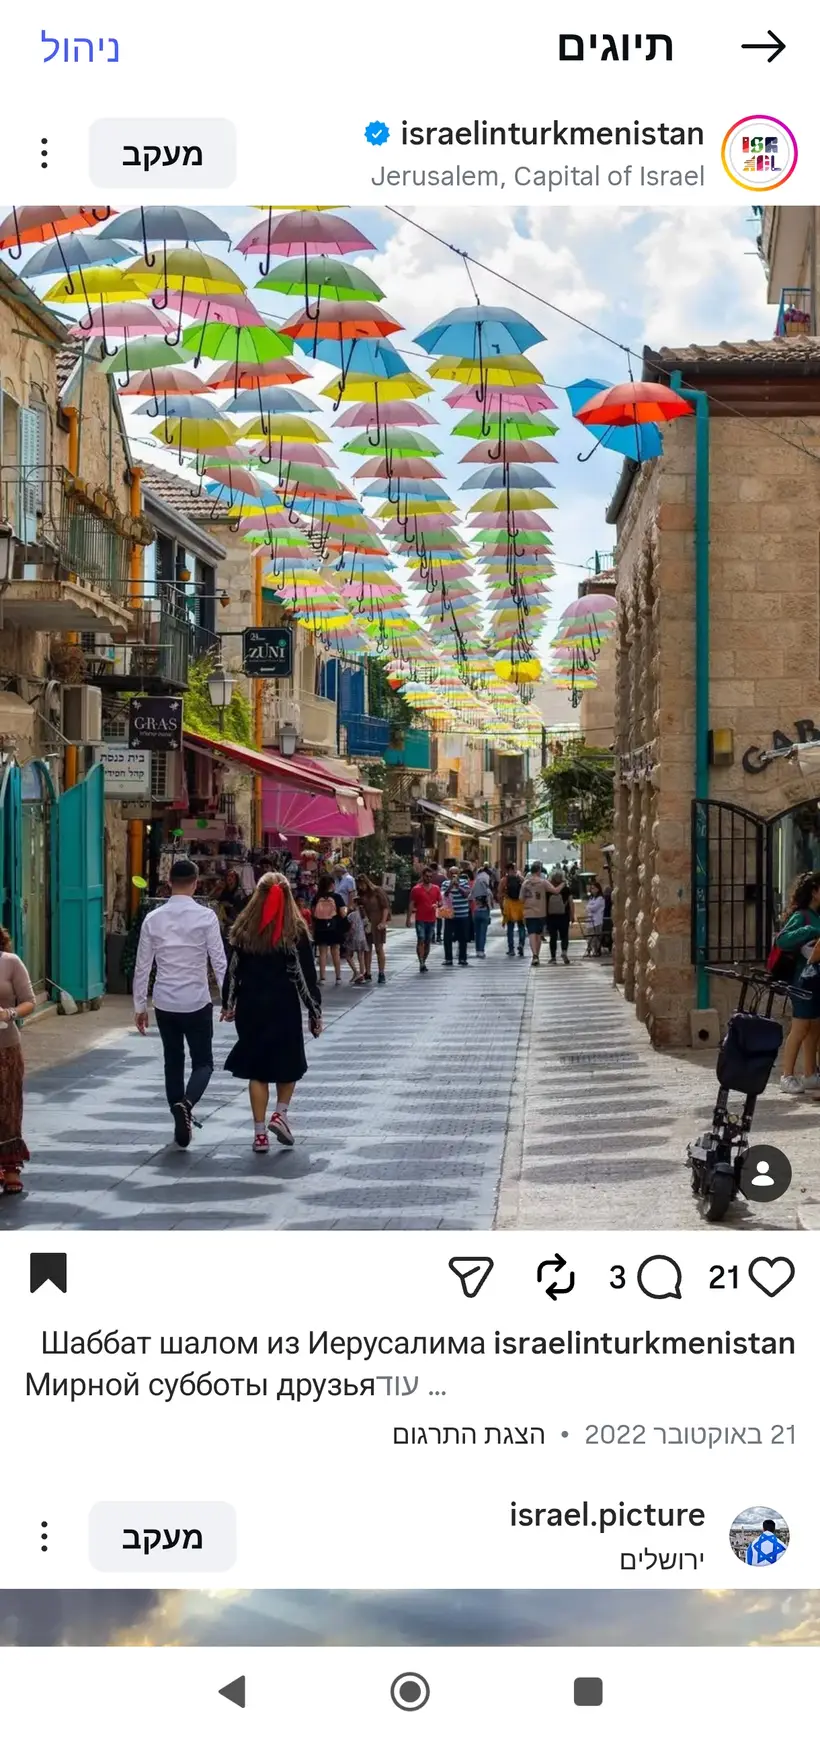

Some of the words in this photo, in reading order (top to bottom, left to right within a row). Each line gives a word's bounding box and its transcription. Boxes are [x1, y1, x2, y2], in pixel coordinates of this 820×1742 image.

[248, 643, 286, 659] ZUNI
[100, 754, 125, 763] כנסת
[127, 754, 145, 763] בית
[104, 770, 126, 778] חסידי
